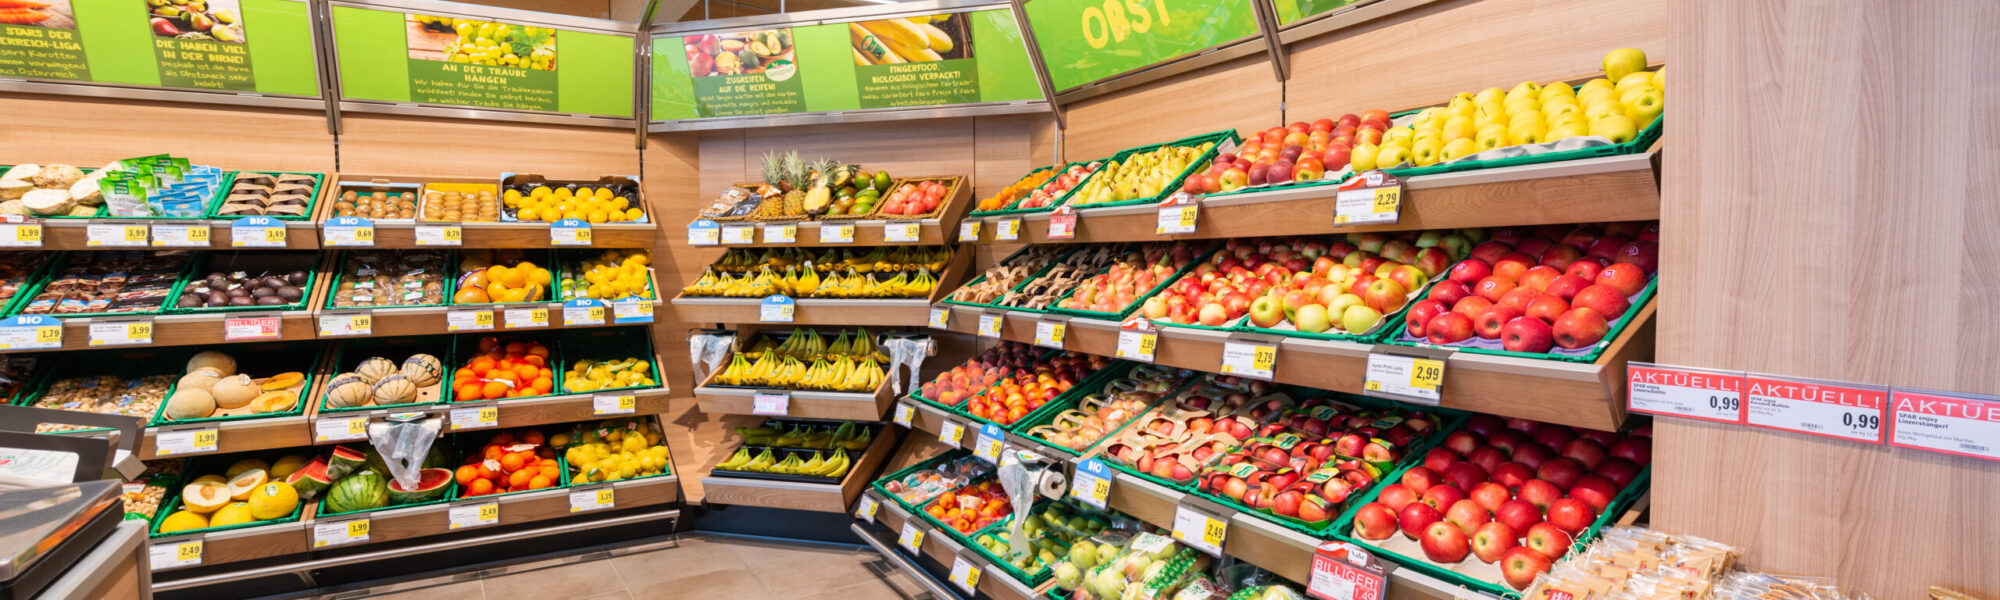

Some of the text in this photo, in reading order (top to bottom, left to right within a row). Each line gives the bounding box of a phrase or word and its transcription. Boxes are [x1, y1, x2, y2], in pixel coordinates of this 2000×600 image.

[6, 27, 73, 40] STARS DER
[155, 39, 247, 55] DIE HABEN VIEL
[28, 49, 78, 60] Karotten
[162, 50, 244, 65] IN DER BIRNE!
[442, 64, 527, 77] AN DER TRAUBE
[464, 74, 507, 85] HÄNGEN
[726, 75, 765, 86] ZUGREIFEN
[872, 71, 961, 84] BIOLOGISCH VERPACKT!
[431, 80, 454, 88] haben
[719, 83, 775, 94] AUF DIE REIFEN!
[1377, 193, 1397, 207] 2,29
[249, 217, 270, 225] BIO
[339, 217, 358, 226] BIO
[563, 219, 579, 227] BIO
[21, 228, 39, 238] 1,99
[128, 229, 146, 238] 3,99
[191, 229, 207, 238] 2,19
[267, 230, 284, 239] 3,49
[357, 230, 372, 239] 0,69
[576, 299, 592, 307] BIO
[17, 316, 43, 325] BIO
[354, 319, 369, 328] 1,99
[42, 330, 60, 339] 1,79
[132, 327, 150, 336] 3,99
[1257, 351, 1273, 363] 2,79
[1416, 366, 1440, 382] 2,99
[1631, 370, 1740, 392] AKTUELL!
[1749, 382, 1880, 409] AKTUELL!
[1709, 395, 1740, 412] 0,99
[482, 411, 496, 420] 2,99
[1843, 411, 1880, 430] 0,99
[1898, 412, 1938, 424] SPAR enjoy
[1898, 418, 1948, 429] Linzerstangerl
[988, 425, 998, 436] BIO
[199, 434, 215, 444] 1,99
[1088, 461, 1102, 473] BIO
[482, 507, 497, 517] 2,49
[352, 523, 367, 533] 1,99
[1207, 524, 1223, 540] 2,49
[182, 545, 200, 557] 2,49
[1315, 558, 1378, 590] BILLIGER!
